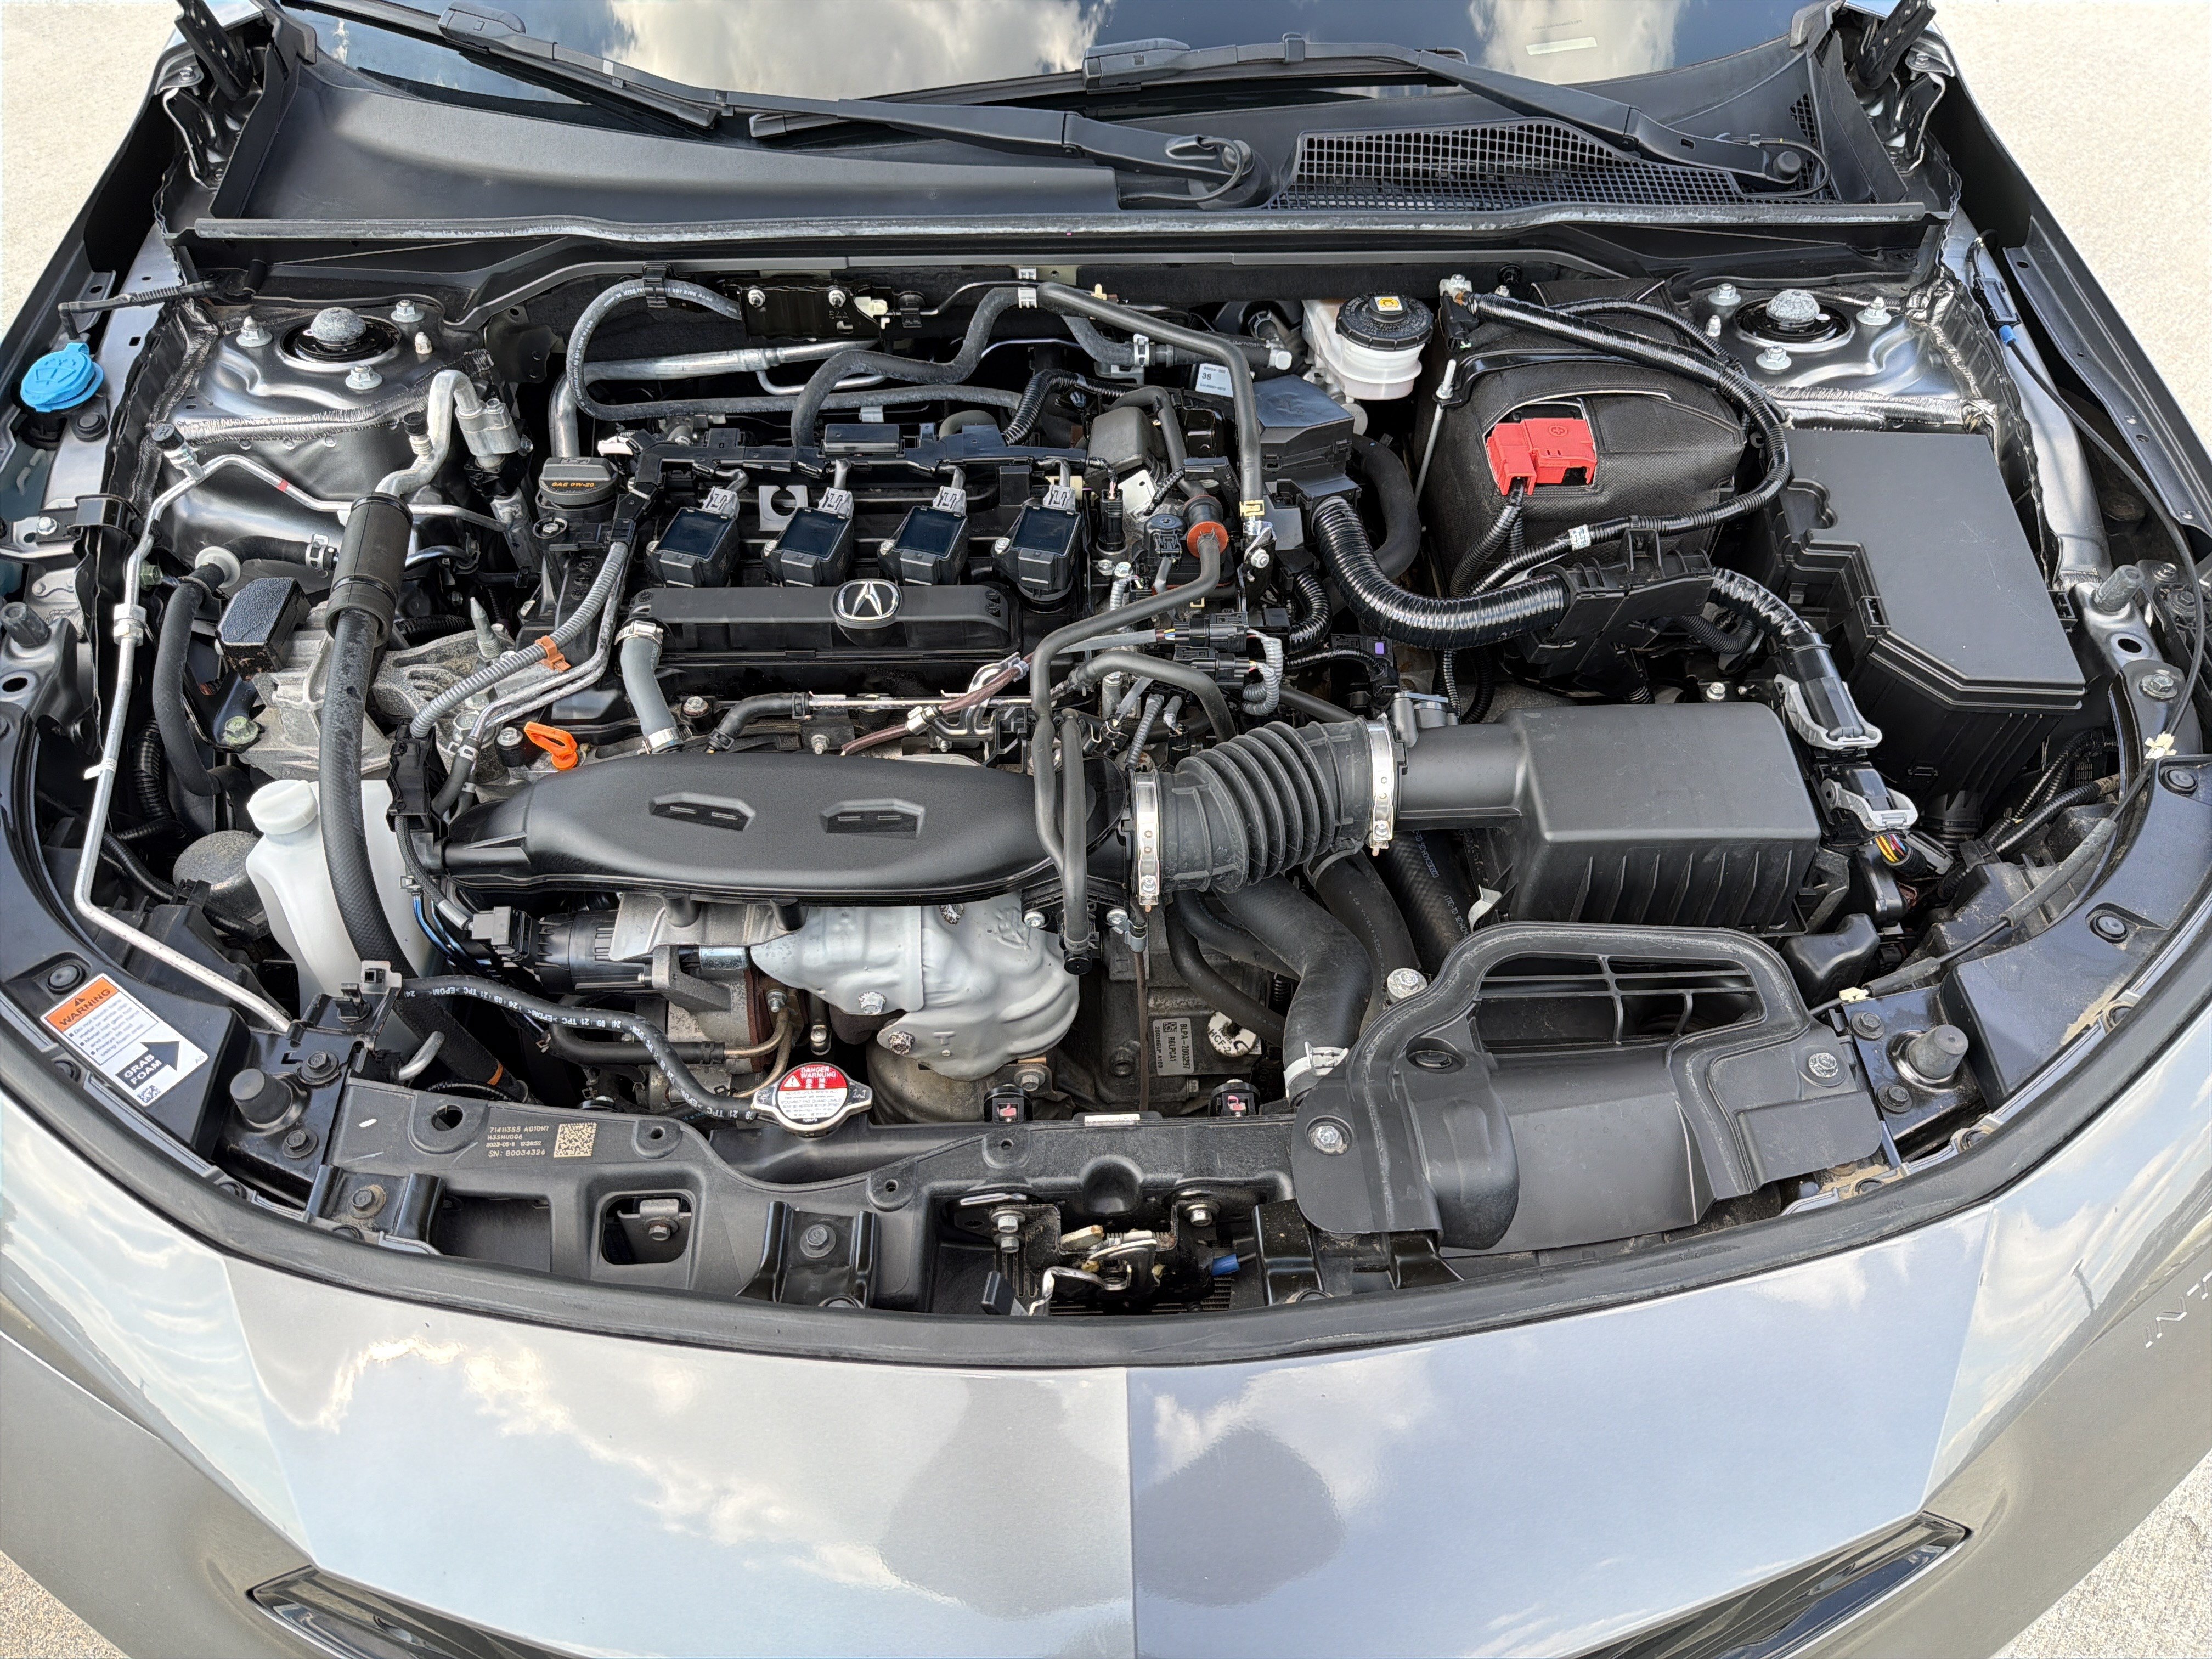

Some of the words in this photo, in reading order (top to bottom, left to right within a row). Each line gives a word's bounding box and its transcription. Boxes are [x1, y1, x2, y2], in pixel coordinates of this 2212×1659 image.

[1201, 372, 1212, 380] 3S
[59, 989, 111, 1026] WARNING
[1208, 1028, 1232, 1053] HCF-2
[123, 1054, 155, 1079] GRAB
[130, 1060, 163, 1085] FOAM
[706, 1107, 725, 1118] TPC
